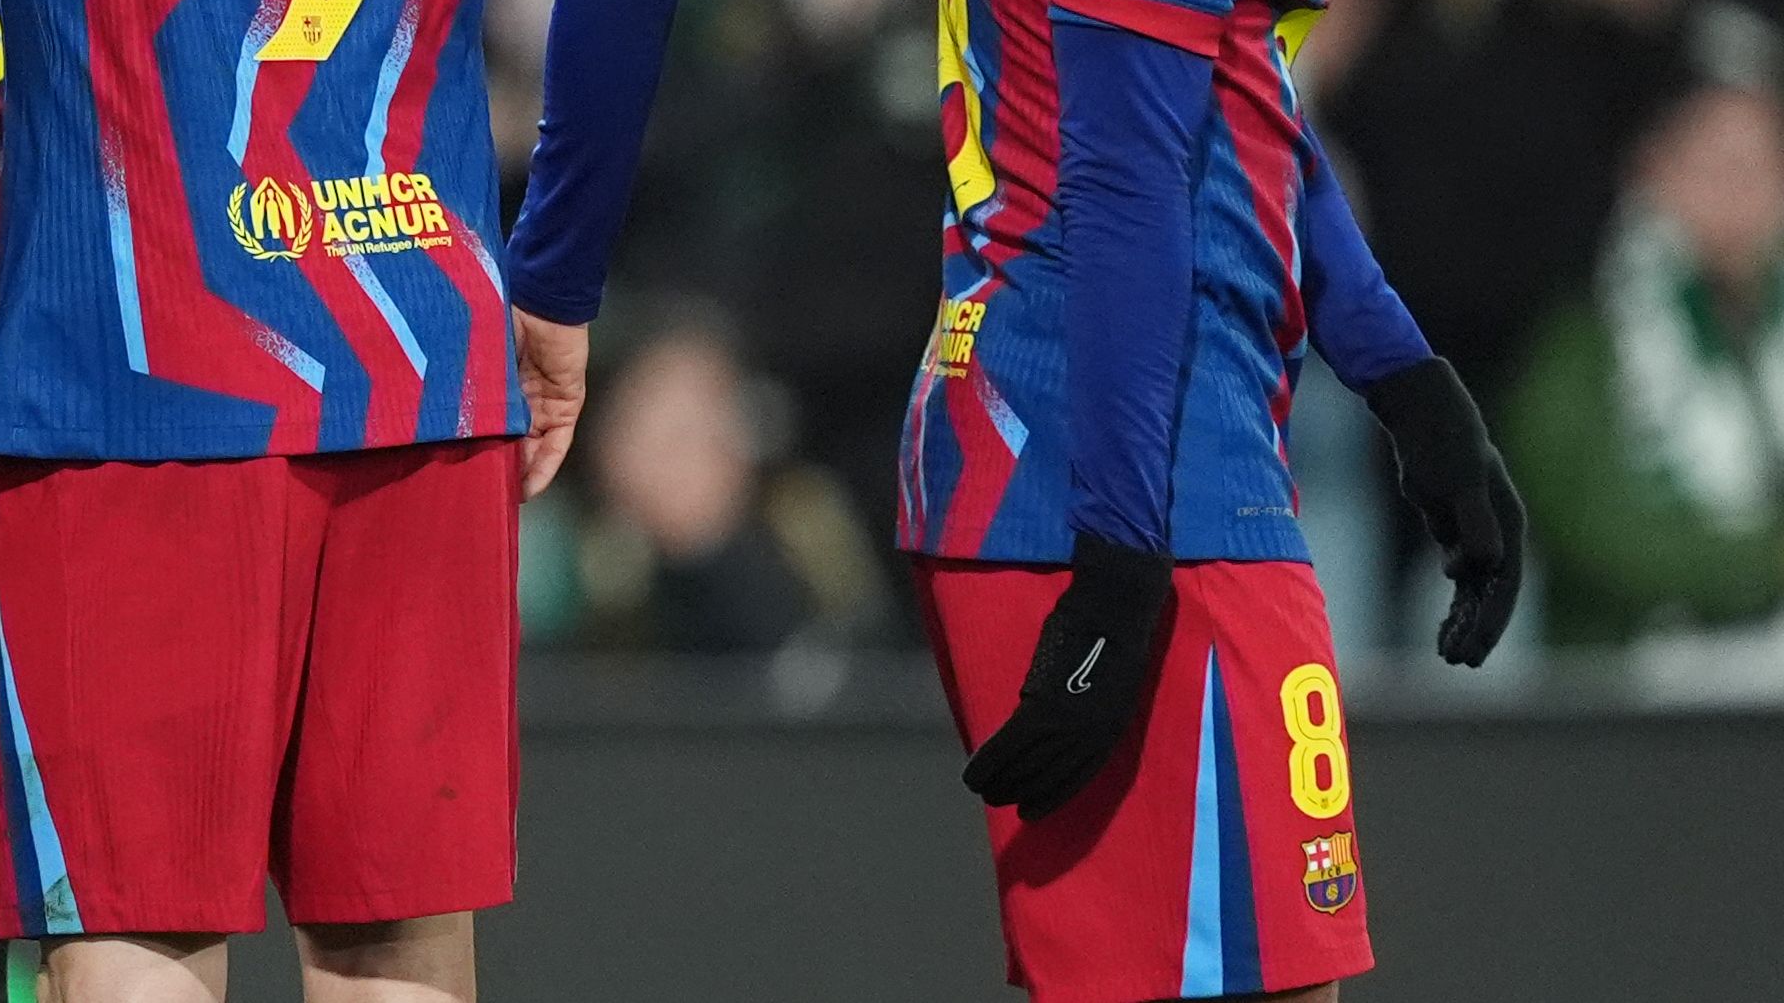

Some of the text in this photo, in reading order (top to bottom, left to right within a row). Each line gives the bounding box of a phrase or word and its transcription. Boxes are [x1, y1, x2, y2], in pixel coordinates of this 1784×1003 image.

[311, 172, 438, 211] UNHCR
[322, 203, 450, 244] ACNUR
[324, 235, 453, 258] The UN Refugee Agency
[1280, 663, 1350, 819] 8
